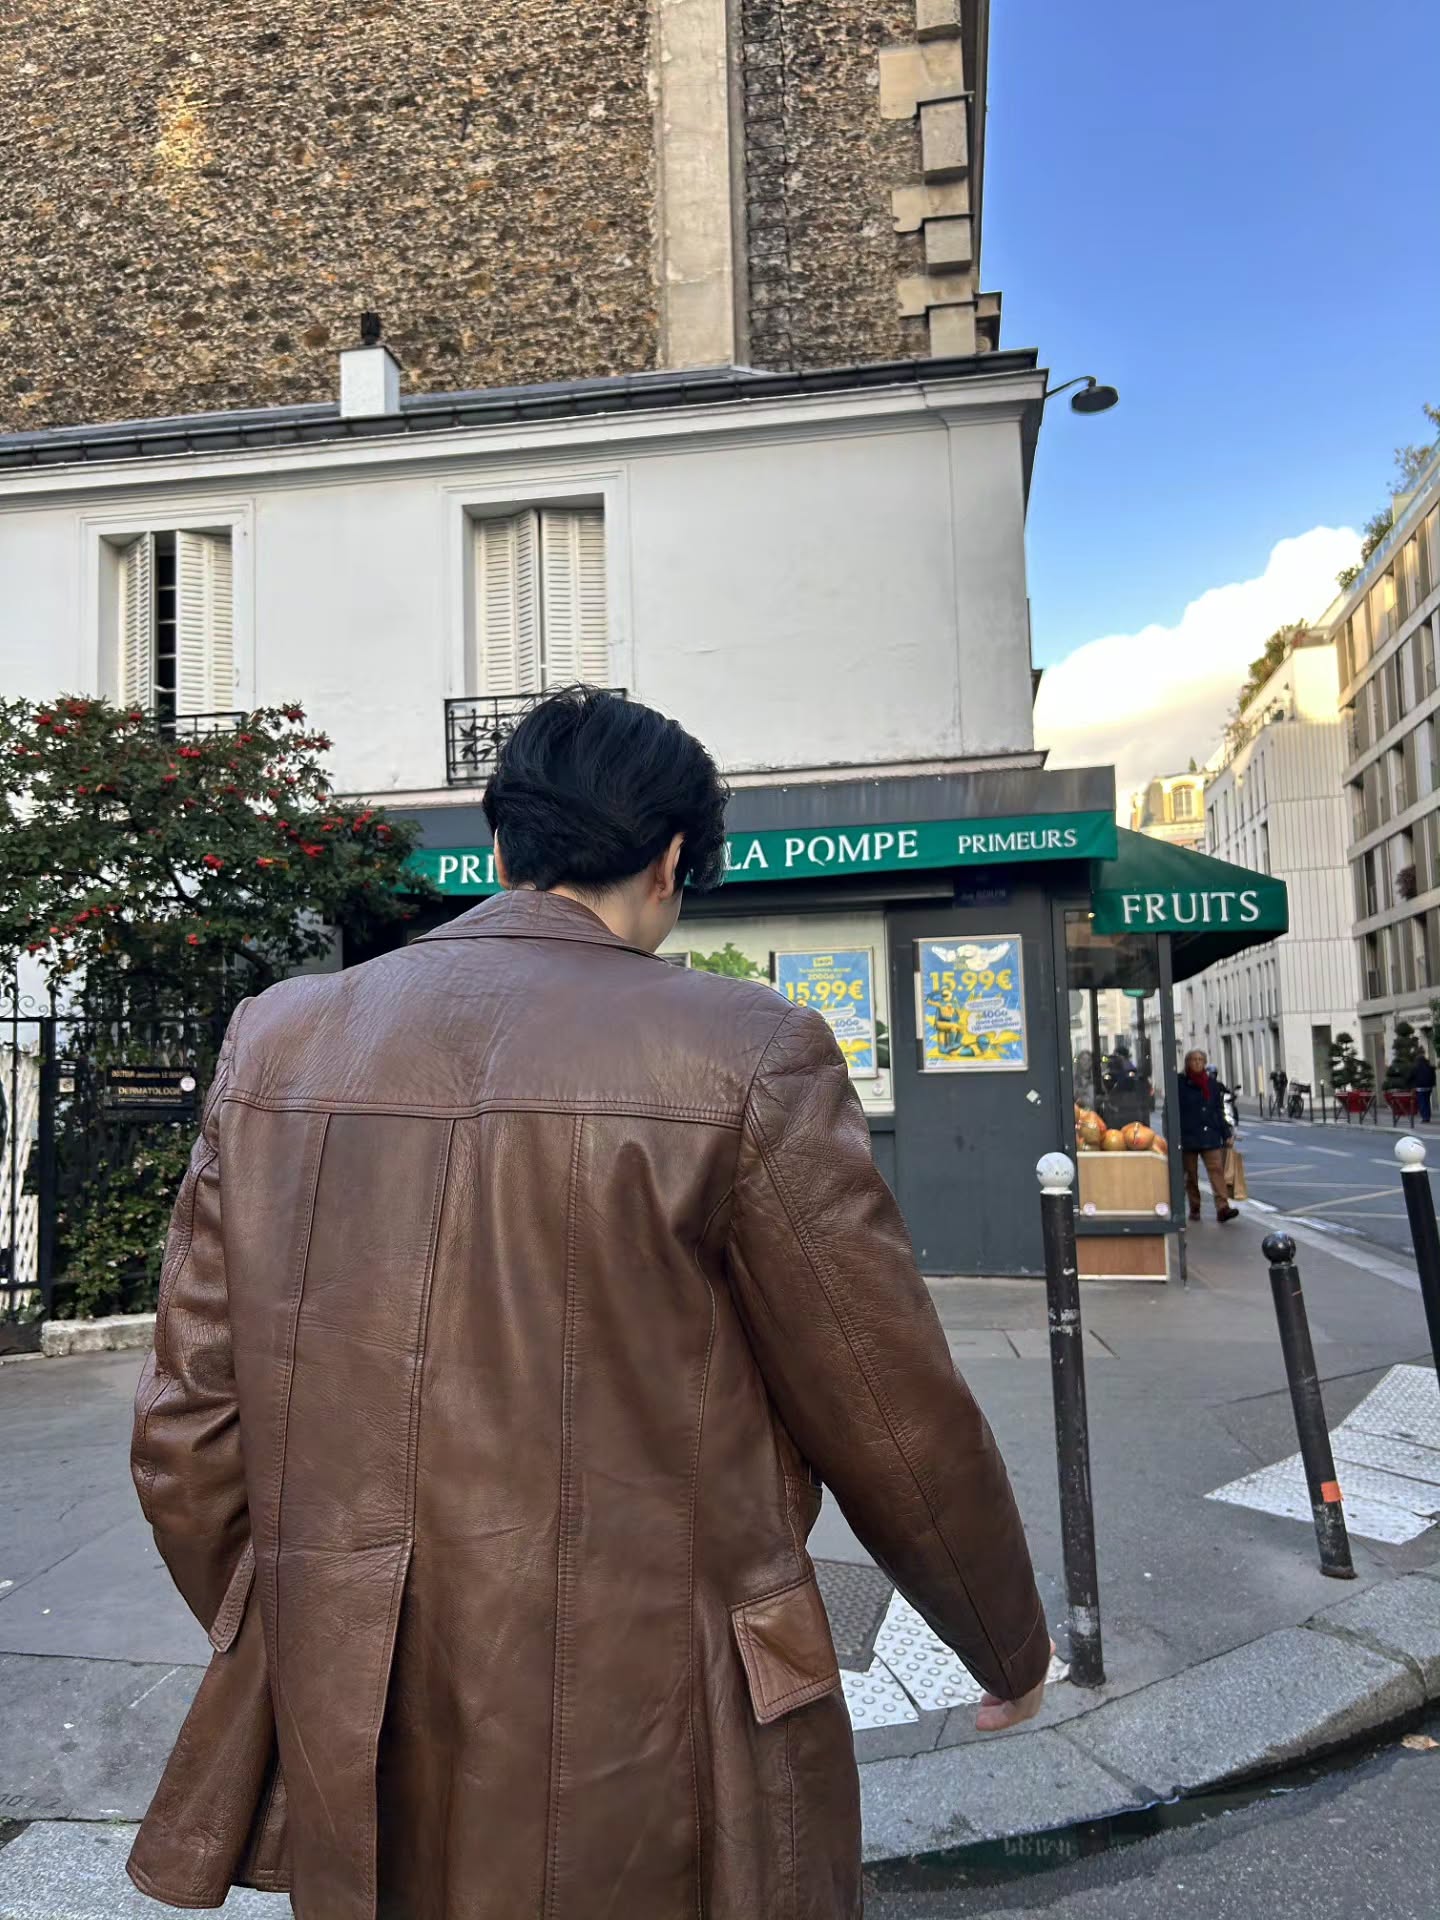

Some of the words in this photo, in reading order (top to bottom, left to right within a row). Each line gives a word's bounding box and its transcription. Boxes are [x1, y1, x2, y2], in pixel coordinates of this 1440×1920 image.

[723, 839, 769, 871] LA
[785, 830, 919, 867] POMPE
[958, 829, 1077, 854] PRIMEURS
[1122, 890, 1261, 925] FRUITS
[785, 980, 864, 1002] 15.99€
[930, 969, 1013, 992] 15.99€
